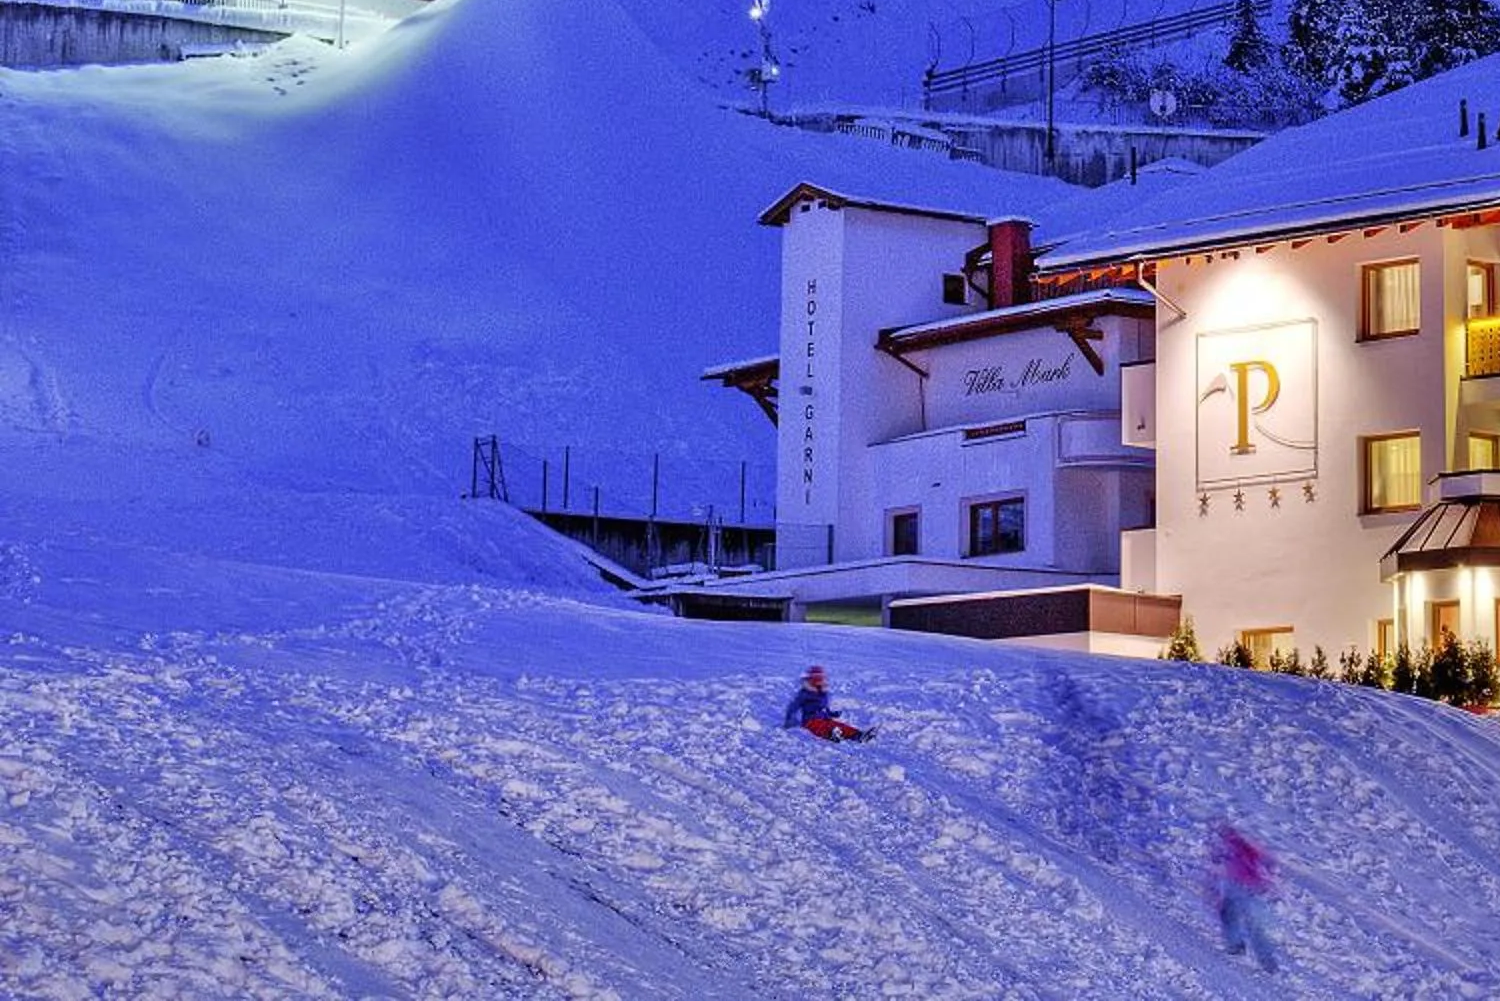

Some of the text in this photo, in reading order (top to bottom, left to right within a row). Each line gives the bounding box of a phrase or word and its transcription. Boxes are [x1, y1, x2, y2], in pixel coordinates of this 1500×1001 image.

[803, 279, 817, 505] HOTEL GARNI
[962, 366, 1004, 396] Villa
[1229, 360, 1281, 456] P
